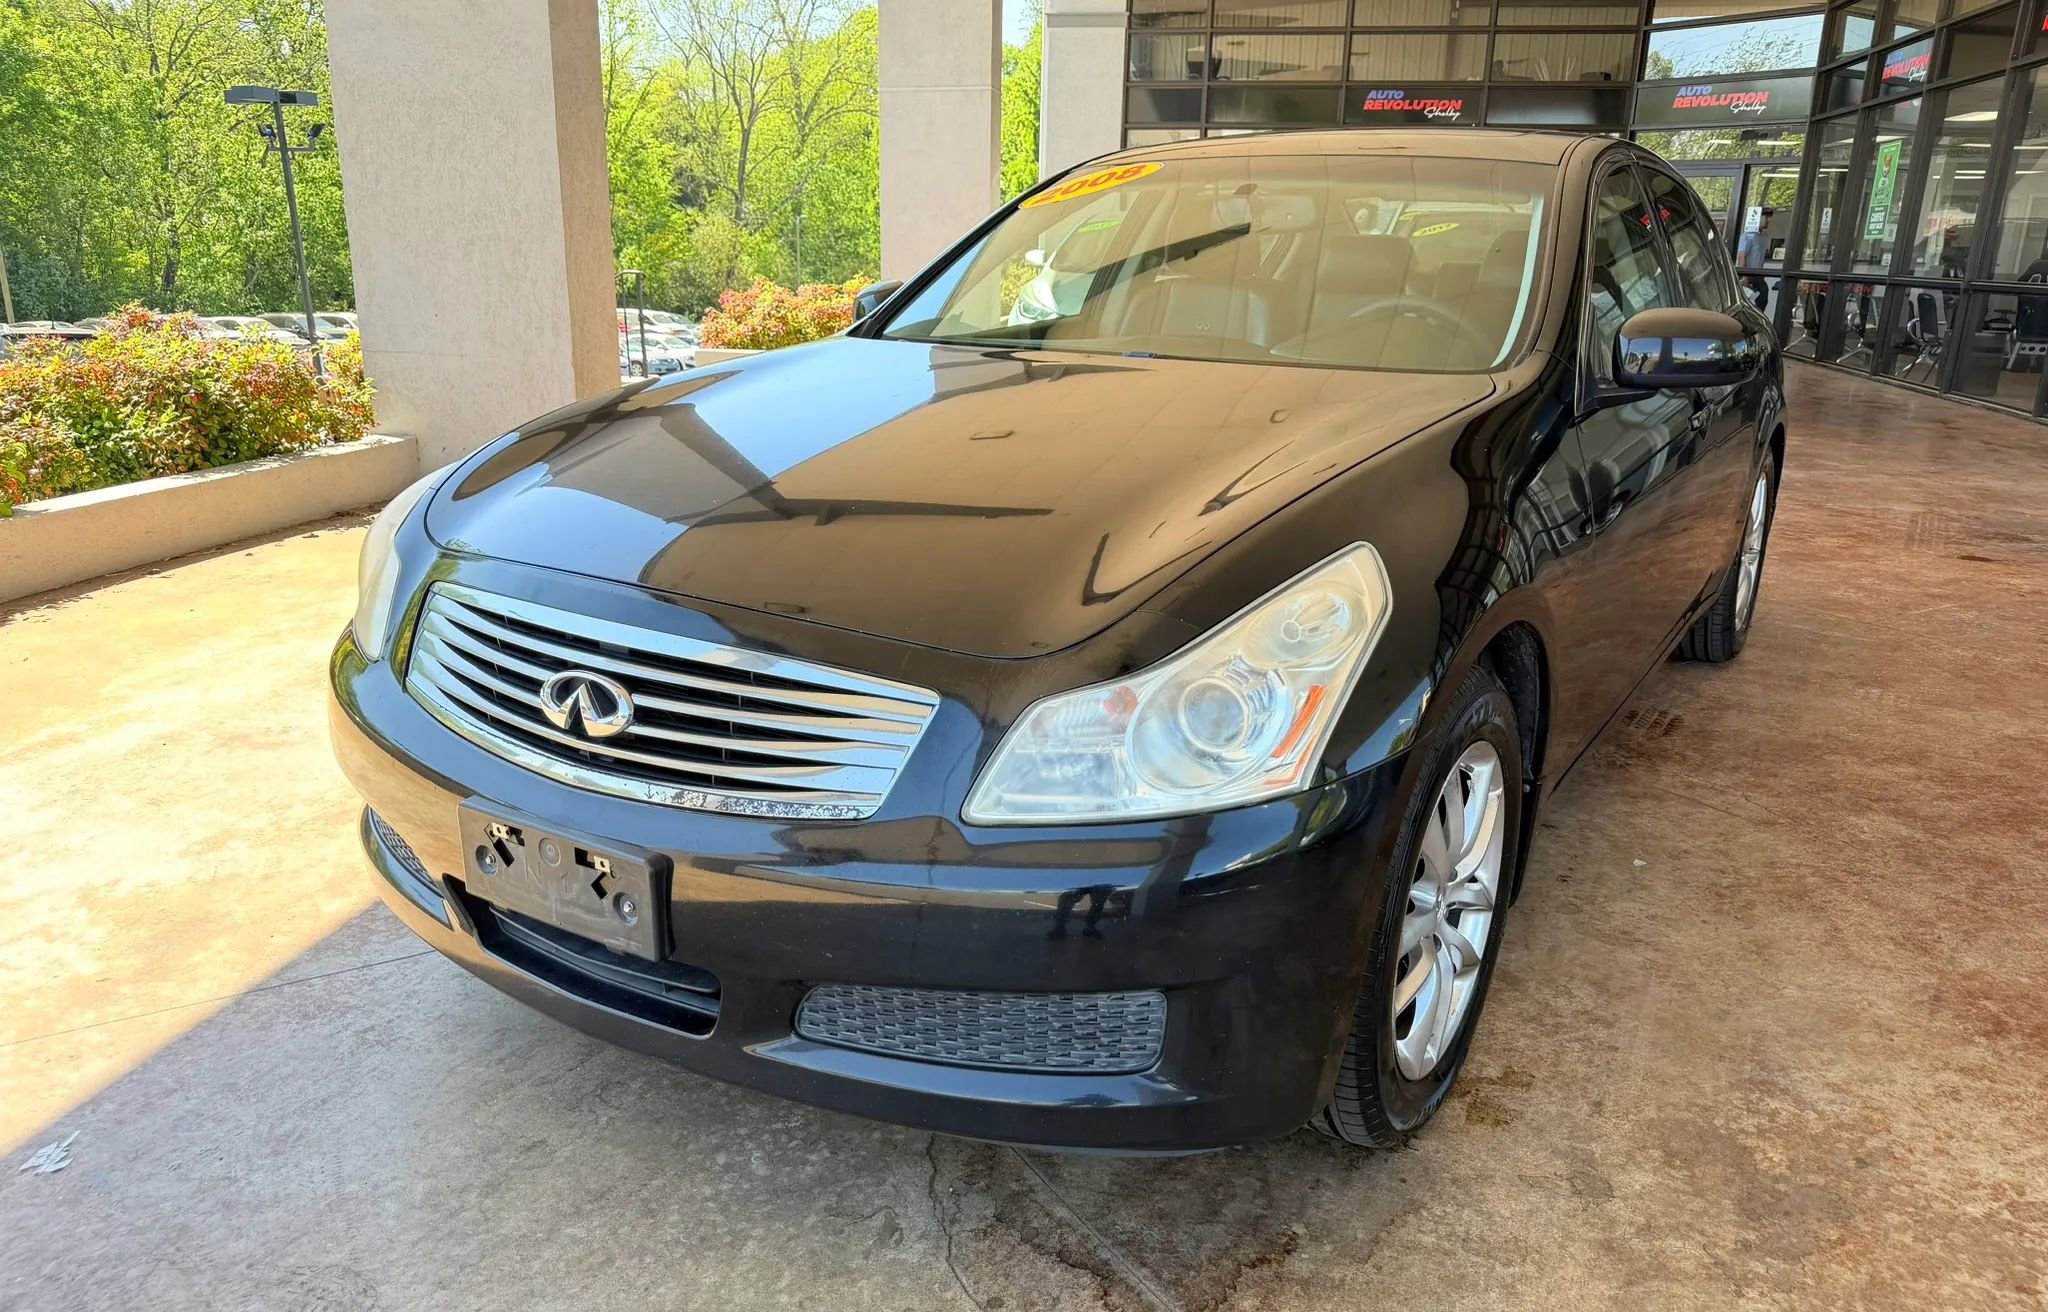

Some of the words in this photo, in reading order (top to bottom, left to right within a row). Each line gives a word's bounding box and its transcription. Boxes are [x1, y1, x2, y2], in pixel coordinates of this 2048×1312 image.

[1367, 90, 1405, 100] AUTO
[1676, 85, 1712, 96] AUTO
[1363, 100, 1463, 110] REVOLUTION
[1672, 91, 1770, 108] REVOLUTION
[1424, 106, 1462, 121] Shelby
[1730, 100, 1767, 115] Shelby
[1030, 164, 1148, 206] 2008
